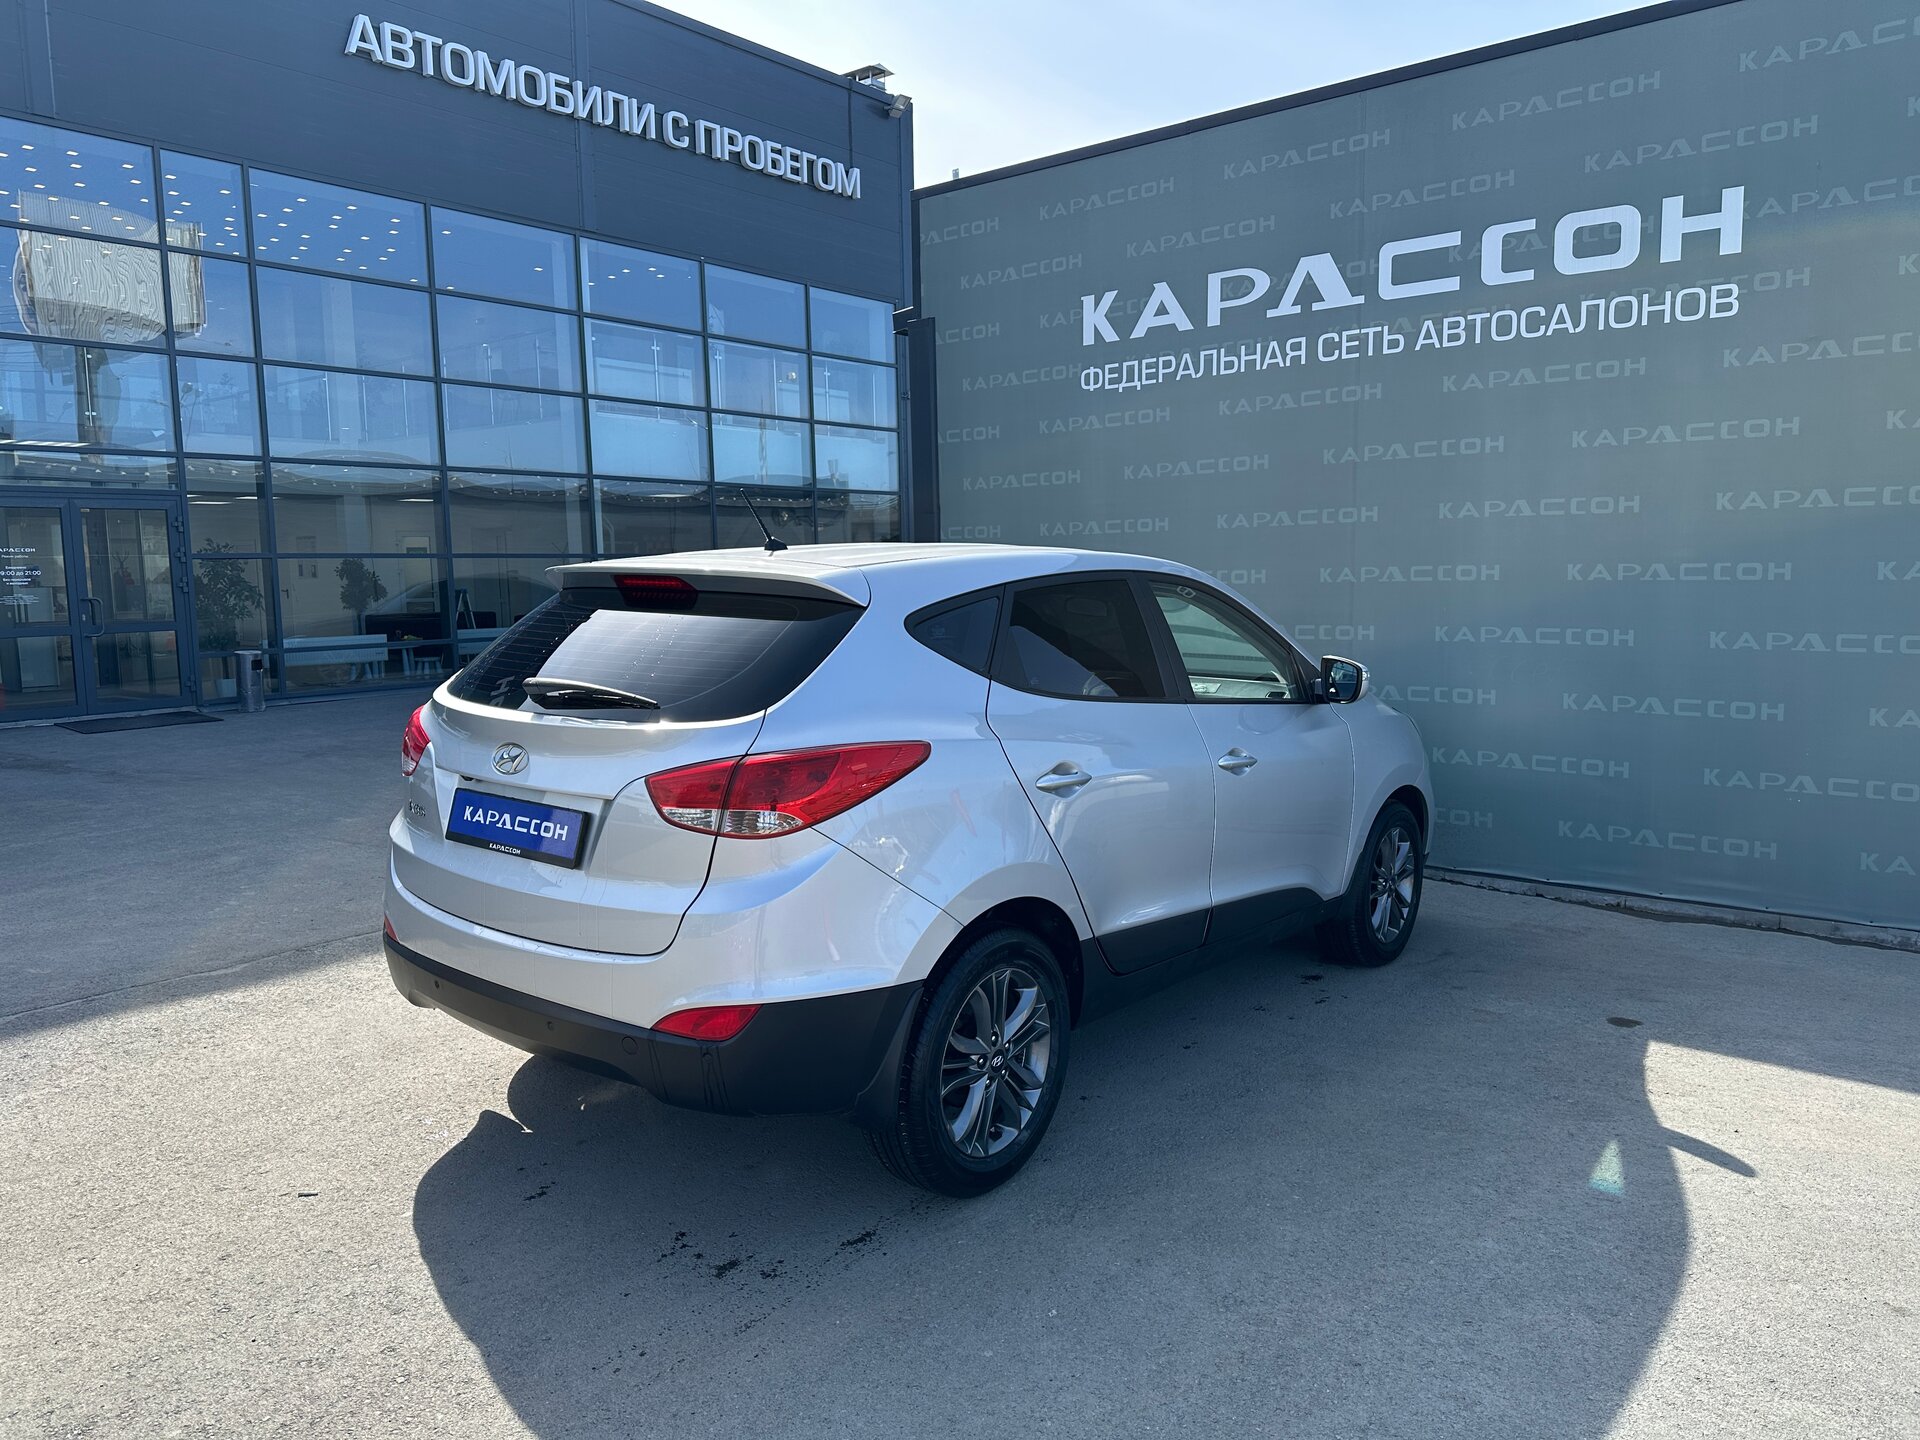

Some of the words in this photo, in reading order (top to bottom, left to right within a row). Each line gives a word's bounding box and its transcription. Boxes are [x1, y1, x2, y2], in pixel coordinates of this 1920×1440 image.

[1738, 16, 1920, 73] КАРАС
[344, 13, 656, 140] АВТОМОБИЛИ
[663, 111, 689, 149] С
[695, 119, 862, 200] ПРОБЕГОМ
[1452, 70, 1661, 131] КАРАССОН
[1224, 129, 1390, 180] КАРАССОН
[1584, 115, 1819, 174] КАРАССОН
[1039, 177, 1175, 222] КАРАССОН
[1329, 169, 1515, 219] КАРАССОН
[1126, 215, 1276, 259] КАРАССОН
[960, 253, 1083, 290] КАРАССОН
[1081, 186, 1745, 347] КАРАССОН
[1080, 337, 1307, 393] ФЕДЕРАЛЬНАЯ
[1317, 326, 1405, 362] СЕТЬ
[1415, 284, 1740, 351] АВТОСАЛОНОВ
[1723, 332, 1920, 368] КАРАСС
[963, 363, 1082, 392] КАРАССОН
[1443, 357, 1647, 393] КАРАССОН
[1219, 383, 1383, 416] КАРАССОН
[1039, 406, 1171, 434] КАРАССОН
[1572, 416, 1800, 449] КАРАССОН
[1322, 435, 1505, 465] КАРАССОН
[963, 469, 1081, 491] КАРАССОН
[1124, 454, 1270, 480] КАРАССОН
[1438, 495, 1640, 520] КАРАССОН
[1715, 485, 1920, 511] КАРАСС
[1039, 517, 1169, 537] КАРАССОН
[1216, 505, 1379, 529] КАРАССОН
[1320, 564, 1501, 584] КАРАССОН
[1567, 562, 1792, 581] КАРАССОН
[1434, 625, 1635, 647] КАРАССОН
[1709, 631, 1920, 655] КАРАССО
[1562, 692, 1785, 721] КАРАССОН
[1432, 747, 1630, 779] КАРАССОН
[1703, 768, 1920, 803] КАРАССО
[464, 805, 568, 841] КАРАССОН
[489, 843, 521, 855] КАРАССОН
[1558, 820, 1777, 861] КАРАССОН
